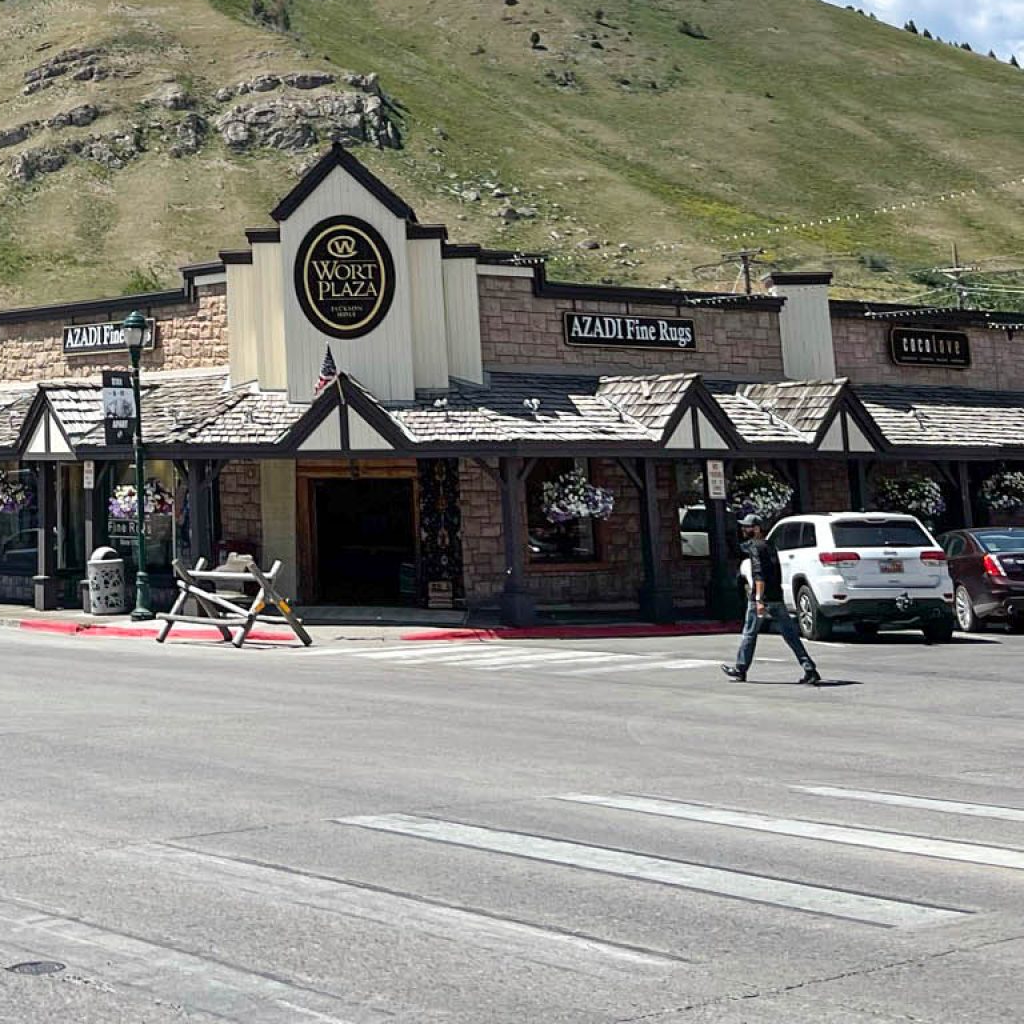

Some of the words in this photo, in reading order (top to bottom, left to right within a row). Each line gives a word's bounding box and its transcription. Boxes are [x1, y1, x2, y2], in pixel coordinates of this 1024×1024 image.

[311, 260, 378, 280] WORT
[317, 281, 378, 300] PLAZA
[65, 326, 101, 349] AZADI
[102, 324, 125, 345] Fine
[571, 316, 625, 339] AZADI
[625, 318, 656, 341] Fine
[657, 320, 692, 347] Rugs
